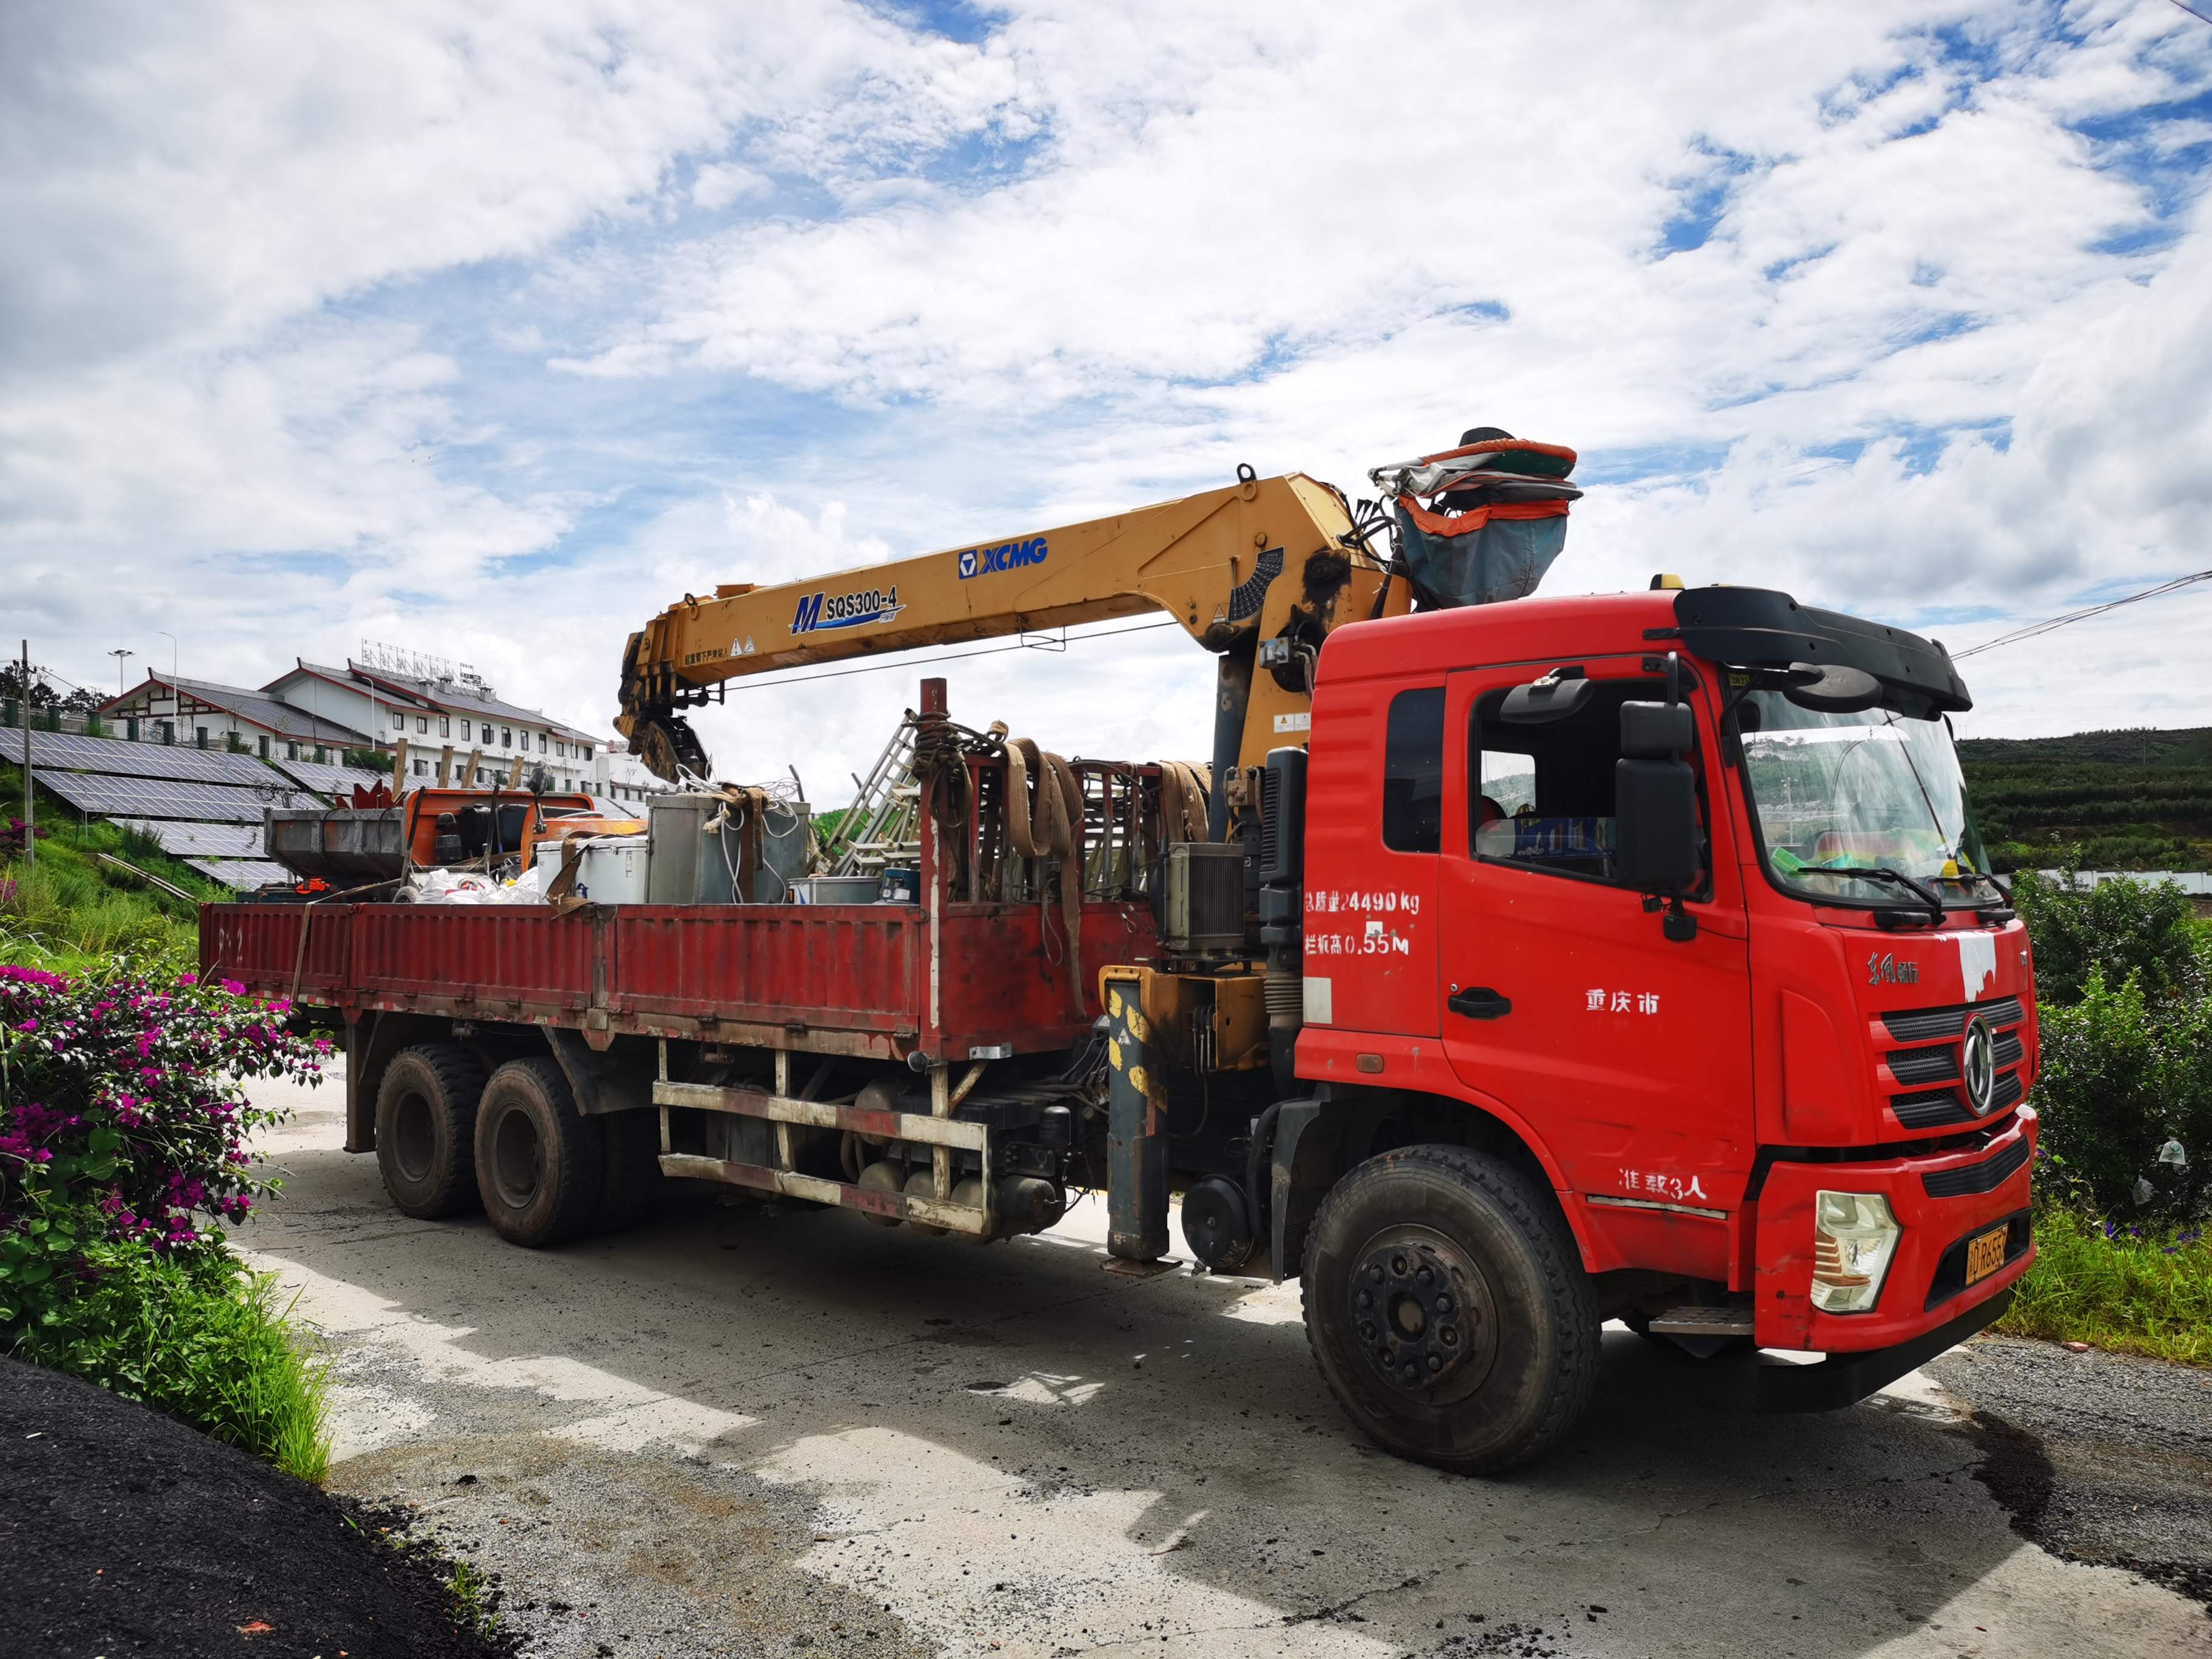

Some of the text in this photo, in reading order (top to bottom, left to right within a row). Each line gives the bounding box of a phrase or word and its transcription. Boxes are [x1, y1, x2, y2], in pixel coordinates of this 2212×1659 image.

[979, 537, 1048, 575] XCMG
[791, 586, 897, 635] M SQS300-4
[1585, 988, 1660, 1015] 重庆市
[1618, 1168, 1708, 1200] 准载3人
